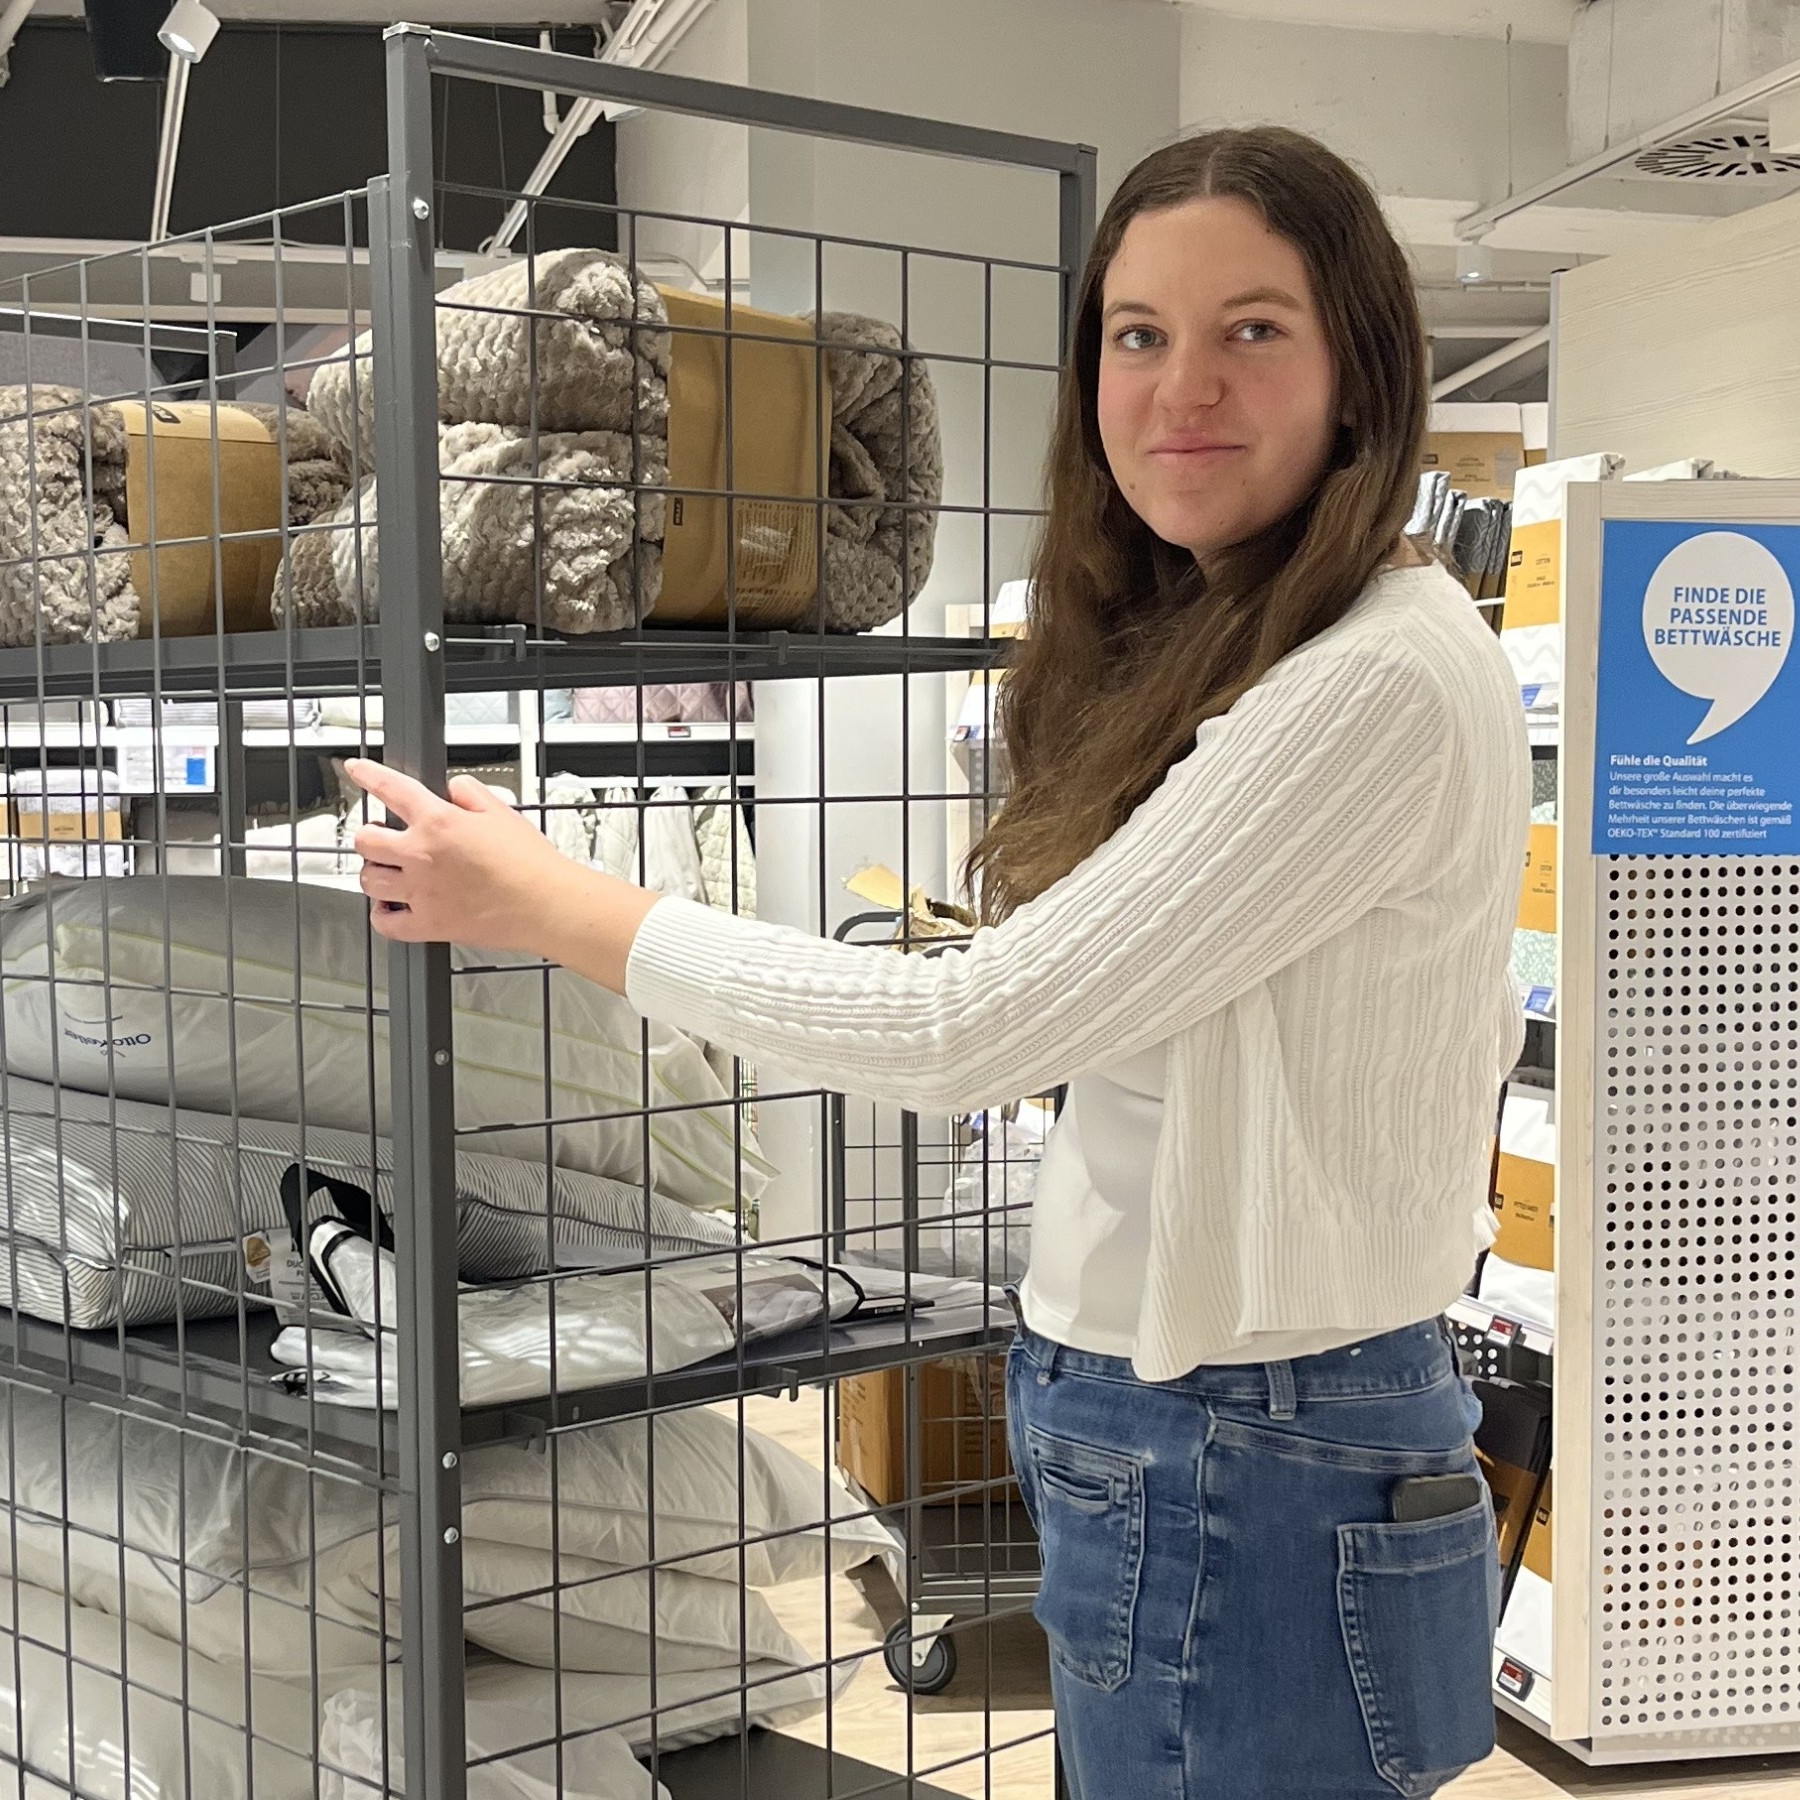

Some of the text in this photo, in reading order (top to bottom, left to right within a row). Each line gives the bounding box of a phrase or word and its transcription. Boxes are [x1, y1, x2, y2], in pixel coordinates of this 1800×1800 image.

[1673, 586, 1766, 605] FINDE DIE
[1670, 608, 1768, 626] PASSENDE
[1654, 625, 1782, 647] BETTWÄSCHE
[1610, 754, 1708, 768] Fühle die Qualität
[1609, 771, 1753, 785] Unsere große Auswahl macht es
[1609, 786, 1765, 799] dir besonders leicht deine perfekte
[1608, 799, 1792, 813] Bettwäsche zu finden. Die überwiegende
[1608, 814, 1792, 827] Mehrheit unserer Bettwäschen ist gemäß
[1660, 828, 1700, 838] Standard
[1703, 829, 1720, 838] 100
[1721, 829, 1767, 839] zertifiziert
